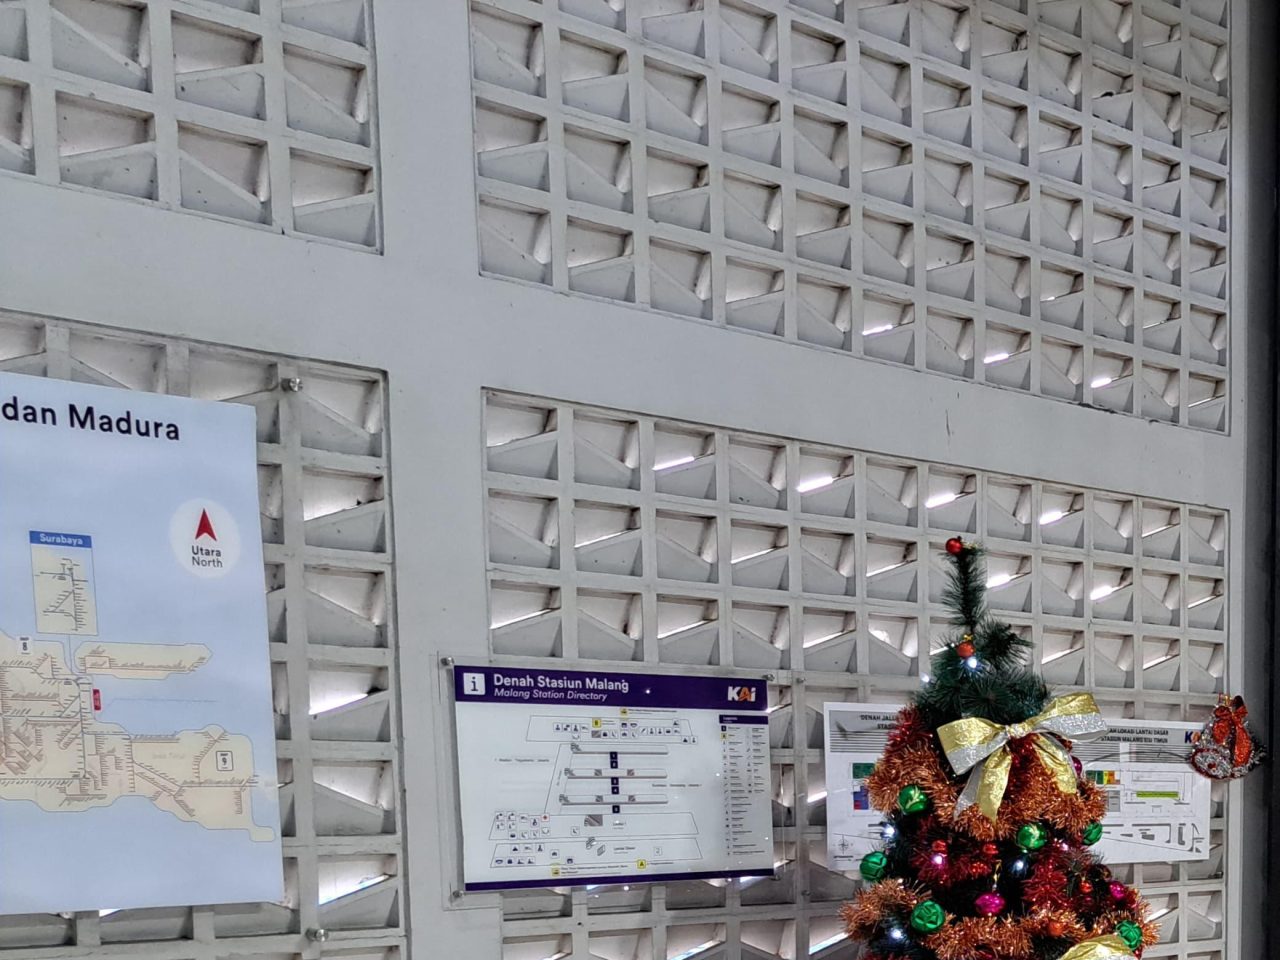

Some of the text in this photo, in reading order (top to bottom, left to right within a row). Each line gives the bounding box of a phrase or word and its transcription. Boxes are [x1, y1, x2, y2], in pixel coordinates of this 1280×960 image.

[2, 396, 180, 441] dan Madura
[40, 533, 84, 547] Surabaya
[191, 545, 222, 558] Utara
[191, 556, 223, 568] North
[493, 673, 630, 694] Denah Stasiun Malang
[493, 688, 608, 702] Malang Station Directory
